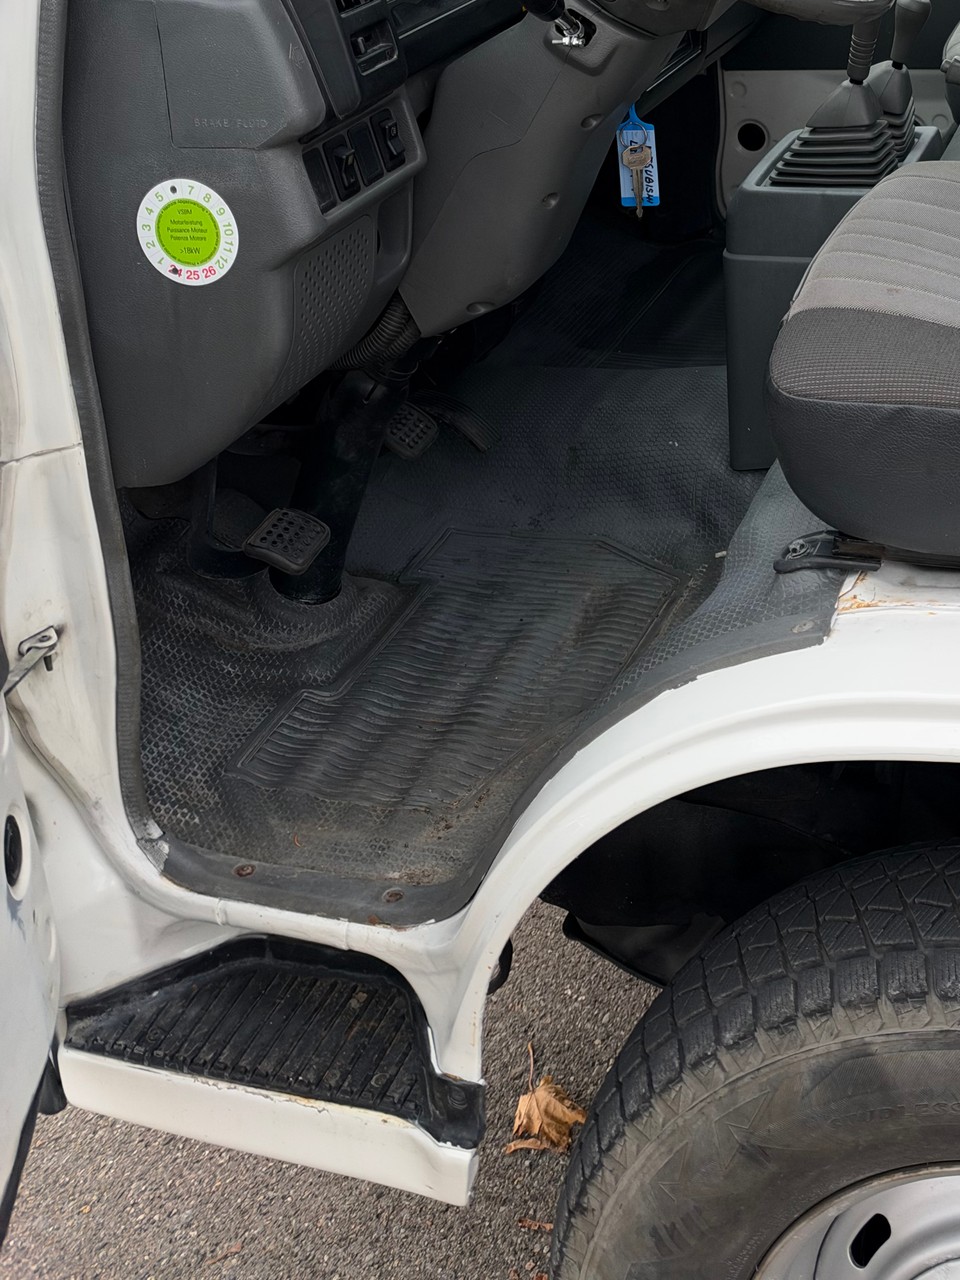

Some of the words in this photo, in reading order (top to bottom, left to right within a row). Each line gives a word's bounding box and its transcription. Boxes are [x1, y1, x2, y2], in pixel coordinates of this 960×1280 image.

[188, 185, 194, 195] 7
[155, 192, 164, 202] 5
[203, 193, 211, 203] 8
[145, 206, 154, 216] 4
[216, 207, 226, 216] 9
[142, 223, 151, 232] 3
[145, 240, 155, 249] 2
[186, 269, 200, 280] 25
[202, 265, 217, 279] 26
